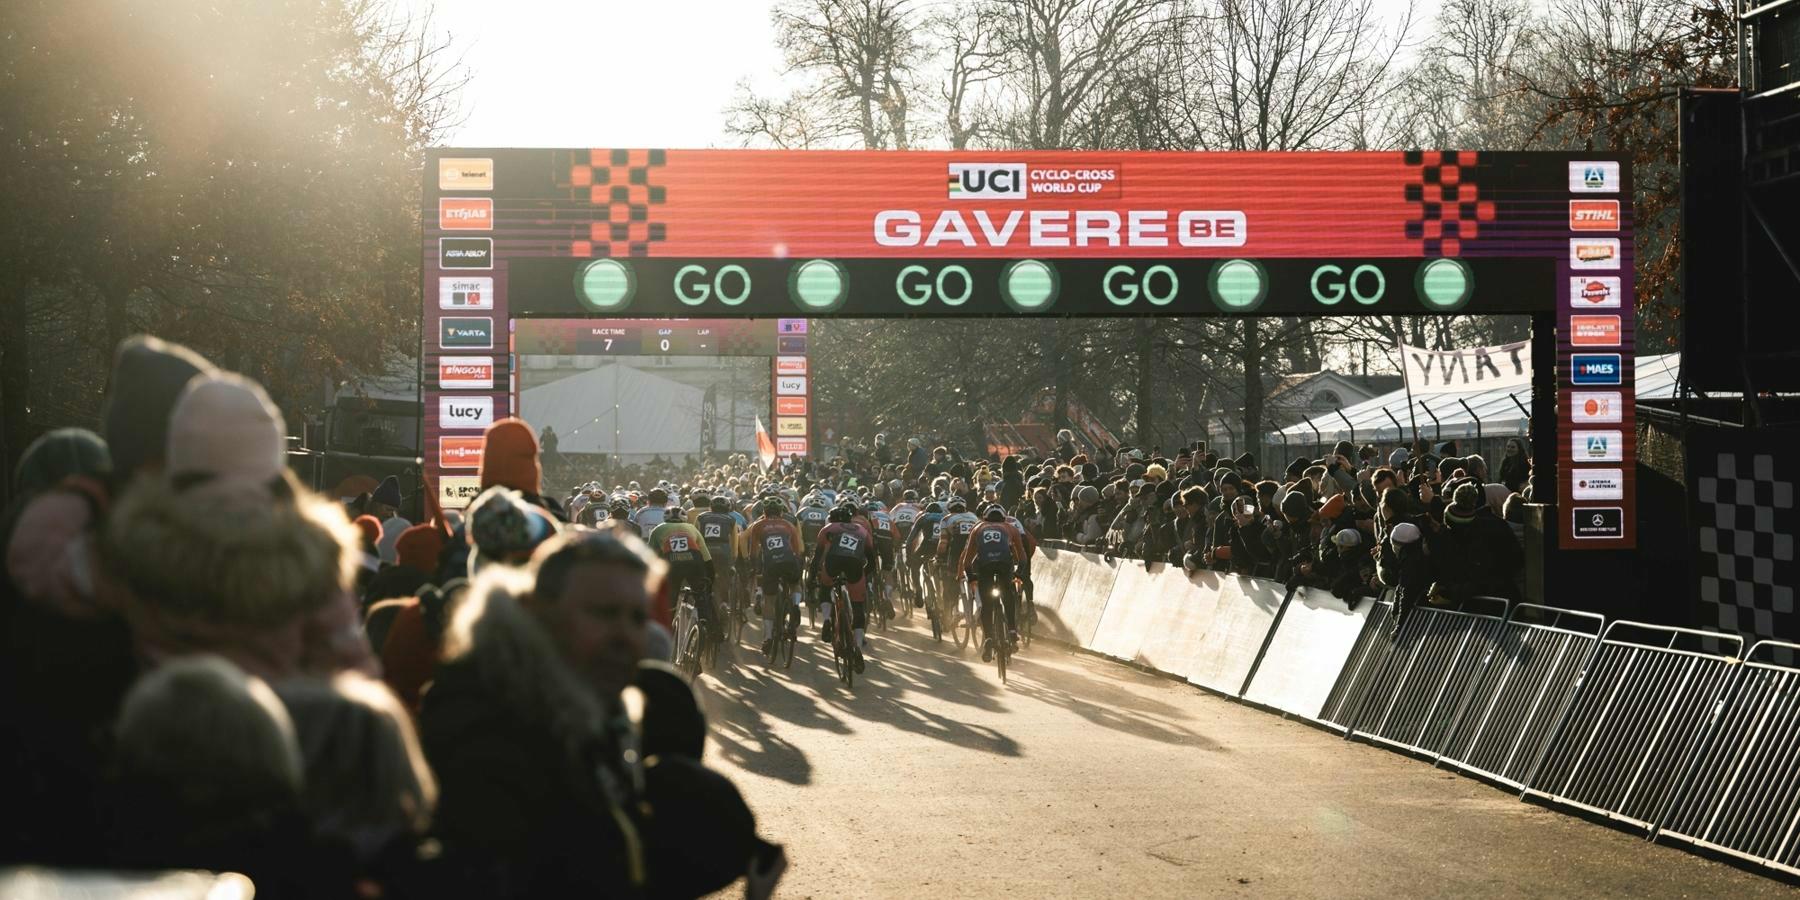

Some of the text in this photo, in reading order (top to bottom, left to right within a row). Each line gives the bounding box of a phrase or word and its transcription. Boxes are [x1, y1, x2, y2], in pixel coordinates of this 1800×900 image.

[961, 168, 1020, 193] UCI
[1030, 170, 1115, 180] CYCLO-CROSS
[1031, 183, 1102, 193] WORLD CUP
[1575, 209, 1615, 221] STIHL
[874, 210, 1236, 247] GAVERE BE
[452, 282, 480, 291] simac
[673, 264, 752, 306] GO
[895, 264, 974, 306] GO
[1102, 264, 1179, 306] GO
[1310, 264, 1386, 305] GO
[456, 329, 486, 337] VARTA
[603, 338, 613, 351] 7
[660, 339, 670, 351] 0
[446, 366, 486, 374] BINGOAL
[1586, 363, 1614, 374] MAES
[782, 381, 801, 390] lucy
[449, 405, 483, 420] lucy
[705, 526, 720, 536] 76
[984, 532, 1000, 541] 68
[671, 539, 687, 550] 75
[768, 538, 781, 548] 67
[841, 535, 858, 547] 37
